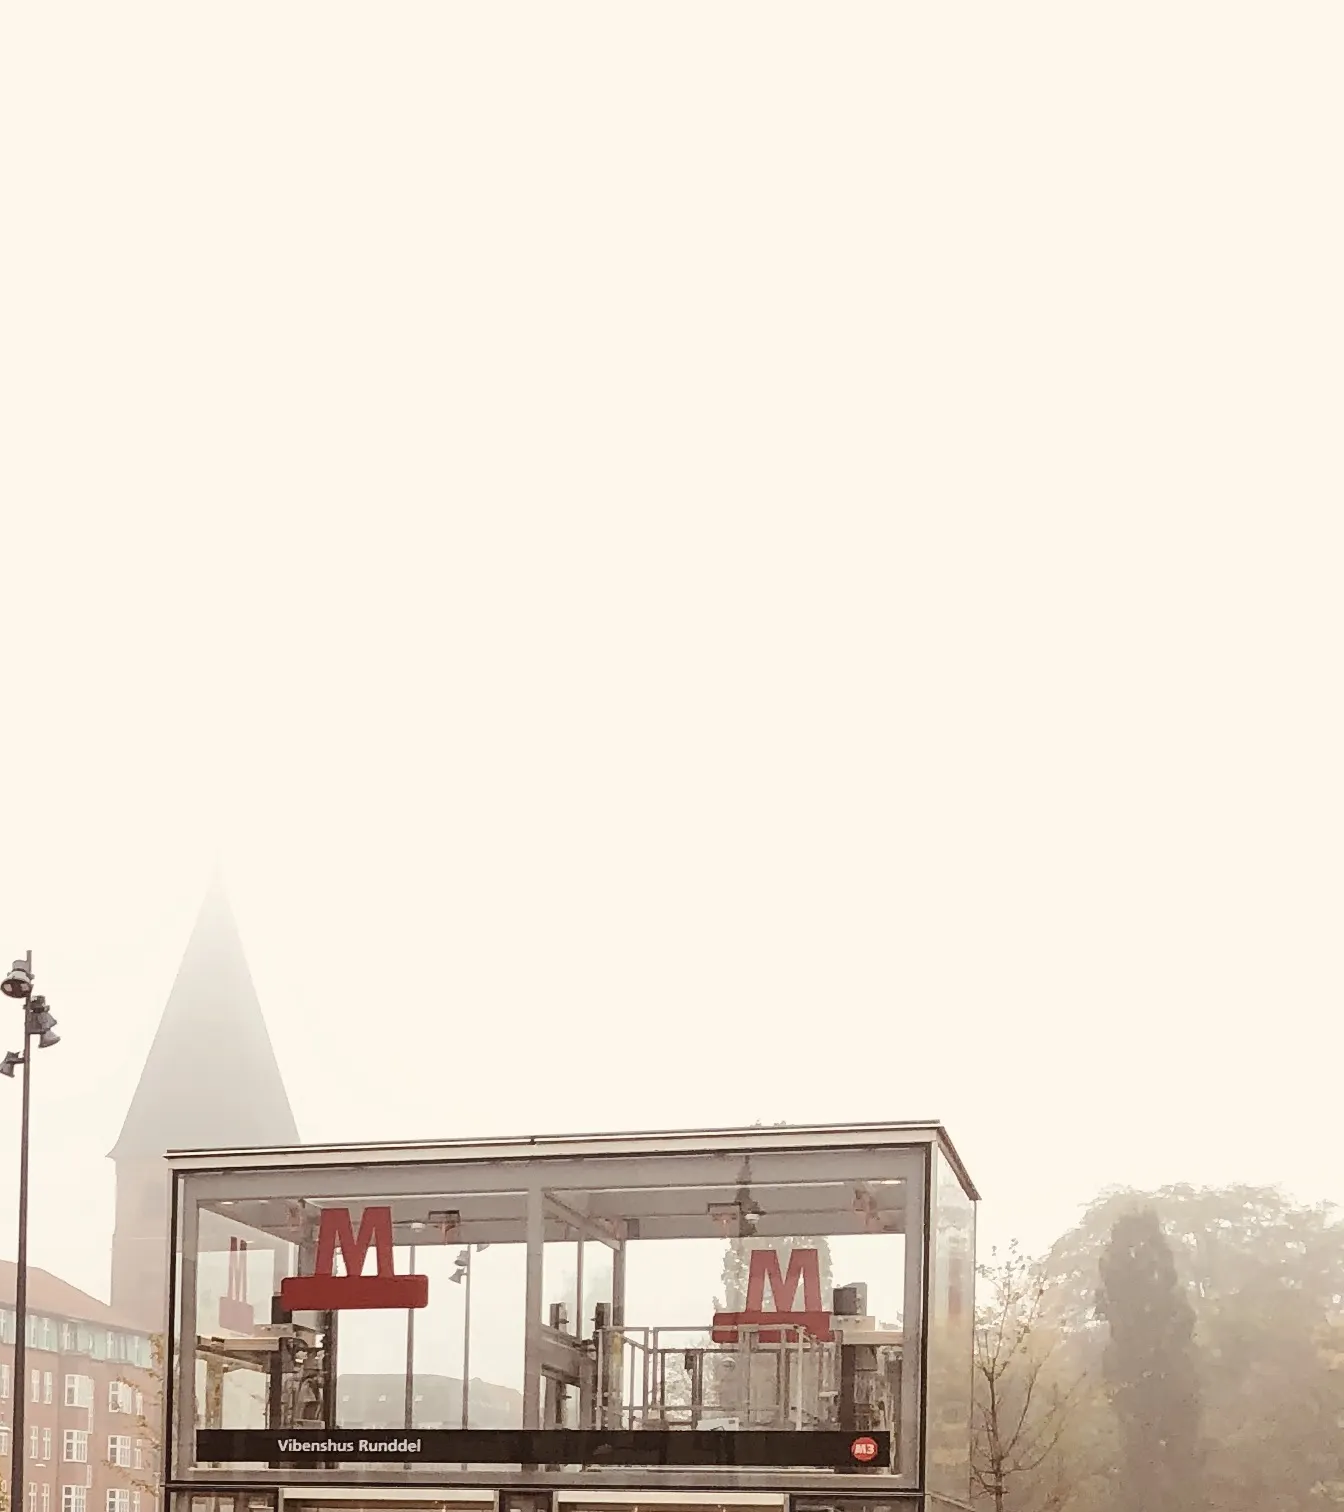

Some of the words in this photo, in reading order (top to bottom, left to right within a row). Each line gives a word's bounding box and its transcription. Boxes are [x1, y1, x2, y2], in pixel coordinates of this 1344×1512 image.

[277, 1438, 354, 1453] Vibenshus
[358, 1438, 422, 1453] Runddel
[854, 1443, 875, 1455] M3
